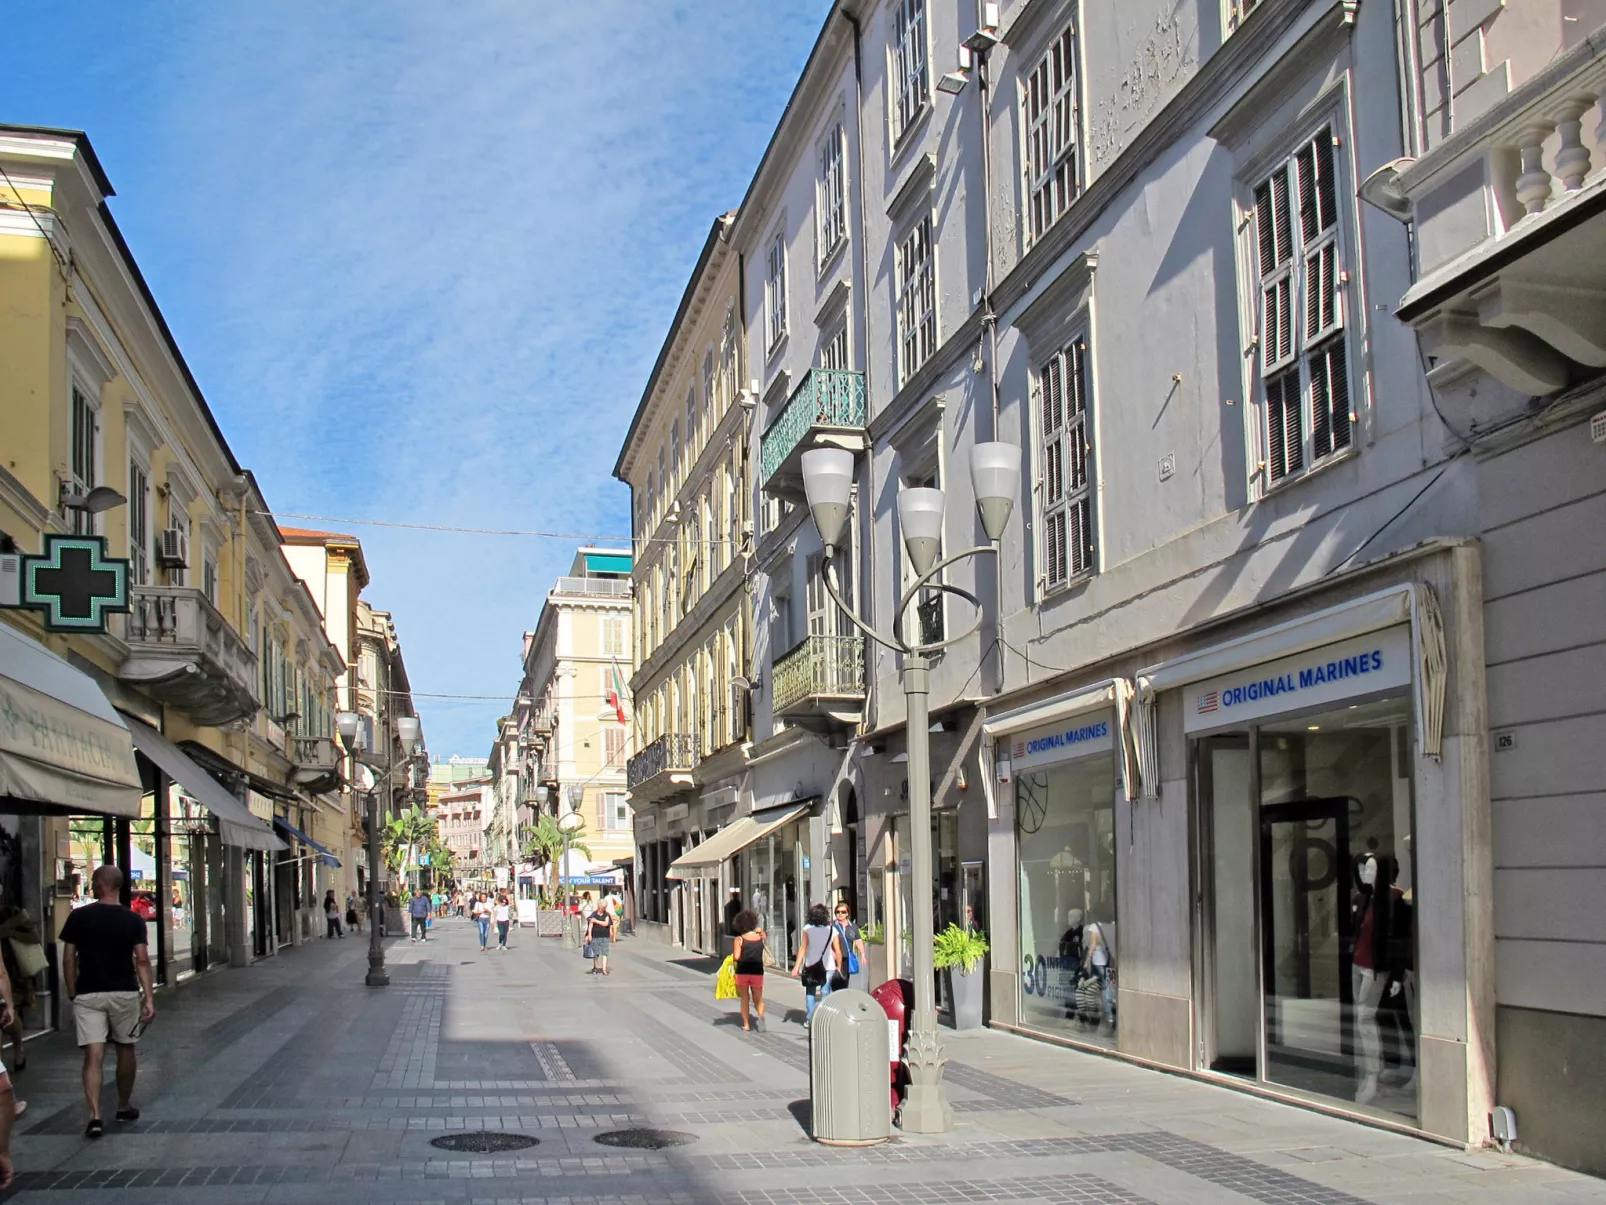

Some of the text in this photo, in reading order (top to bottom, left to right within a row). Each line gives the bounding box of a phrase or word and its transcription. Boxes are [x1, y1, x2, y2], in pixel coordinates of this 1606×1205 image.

[1222, 650, 1384, 708] ORIGINAL MARINES
[1026, 721, 1107, 754] ORIGINAL MARINES
